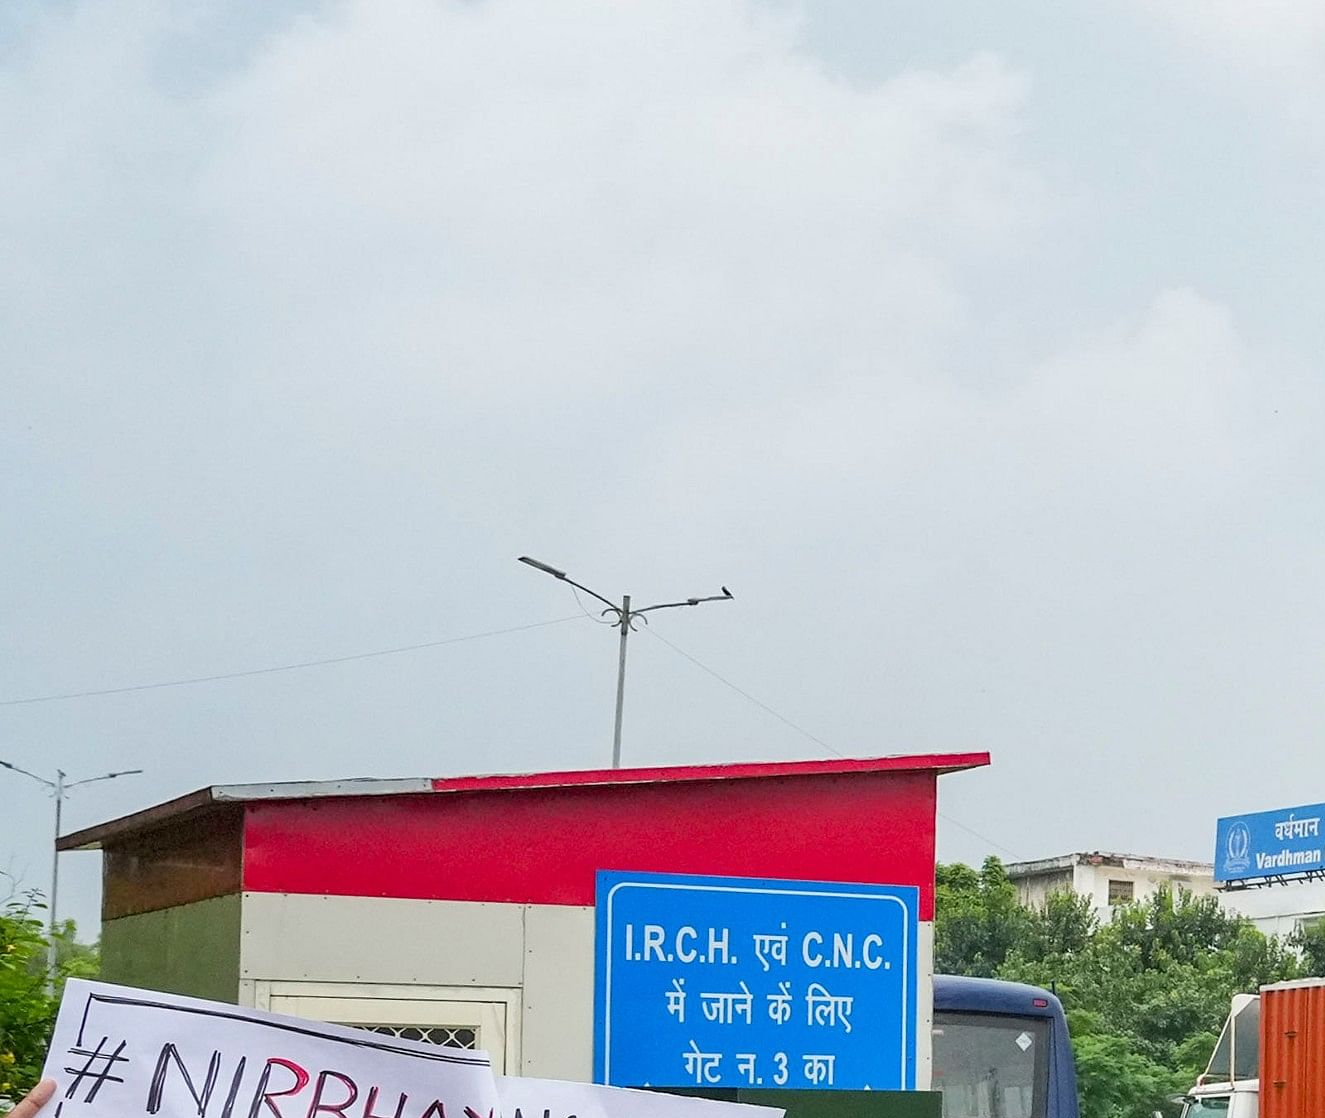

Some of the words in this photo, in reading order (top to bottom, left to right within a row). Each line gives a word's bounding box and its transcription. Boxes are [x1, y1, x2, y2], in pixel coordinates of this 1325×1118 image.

[1275, 813, 1320, 841] वर्धमान
[1256, 849, 1321, 870] Vardhman
[625, 923, 737, 964] I.R.C.H.
[753, 922, 788, 972] एवं
[802, 931, 891, 970] C.N.C.
[665, 978, 686, 1023] में
[700, 980, 753, 1025] जाने
[805, 982, 854, 1033] लिए
[683, 1040, 722, 1083] गेट
[773, 1052, 788, 1085] 3
[802, 1054, 835, 1085] का
